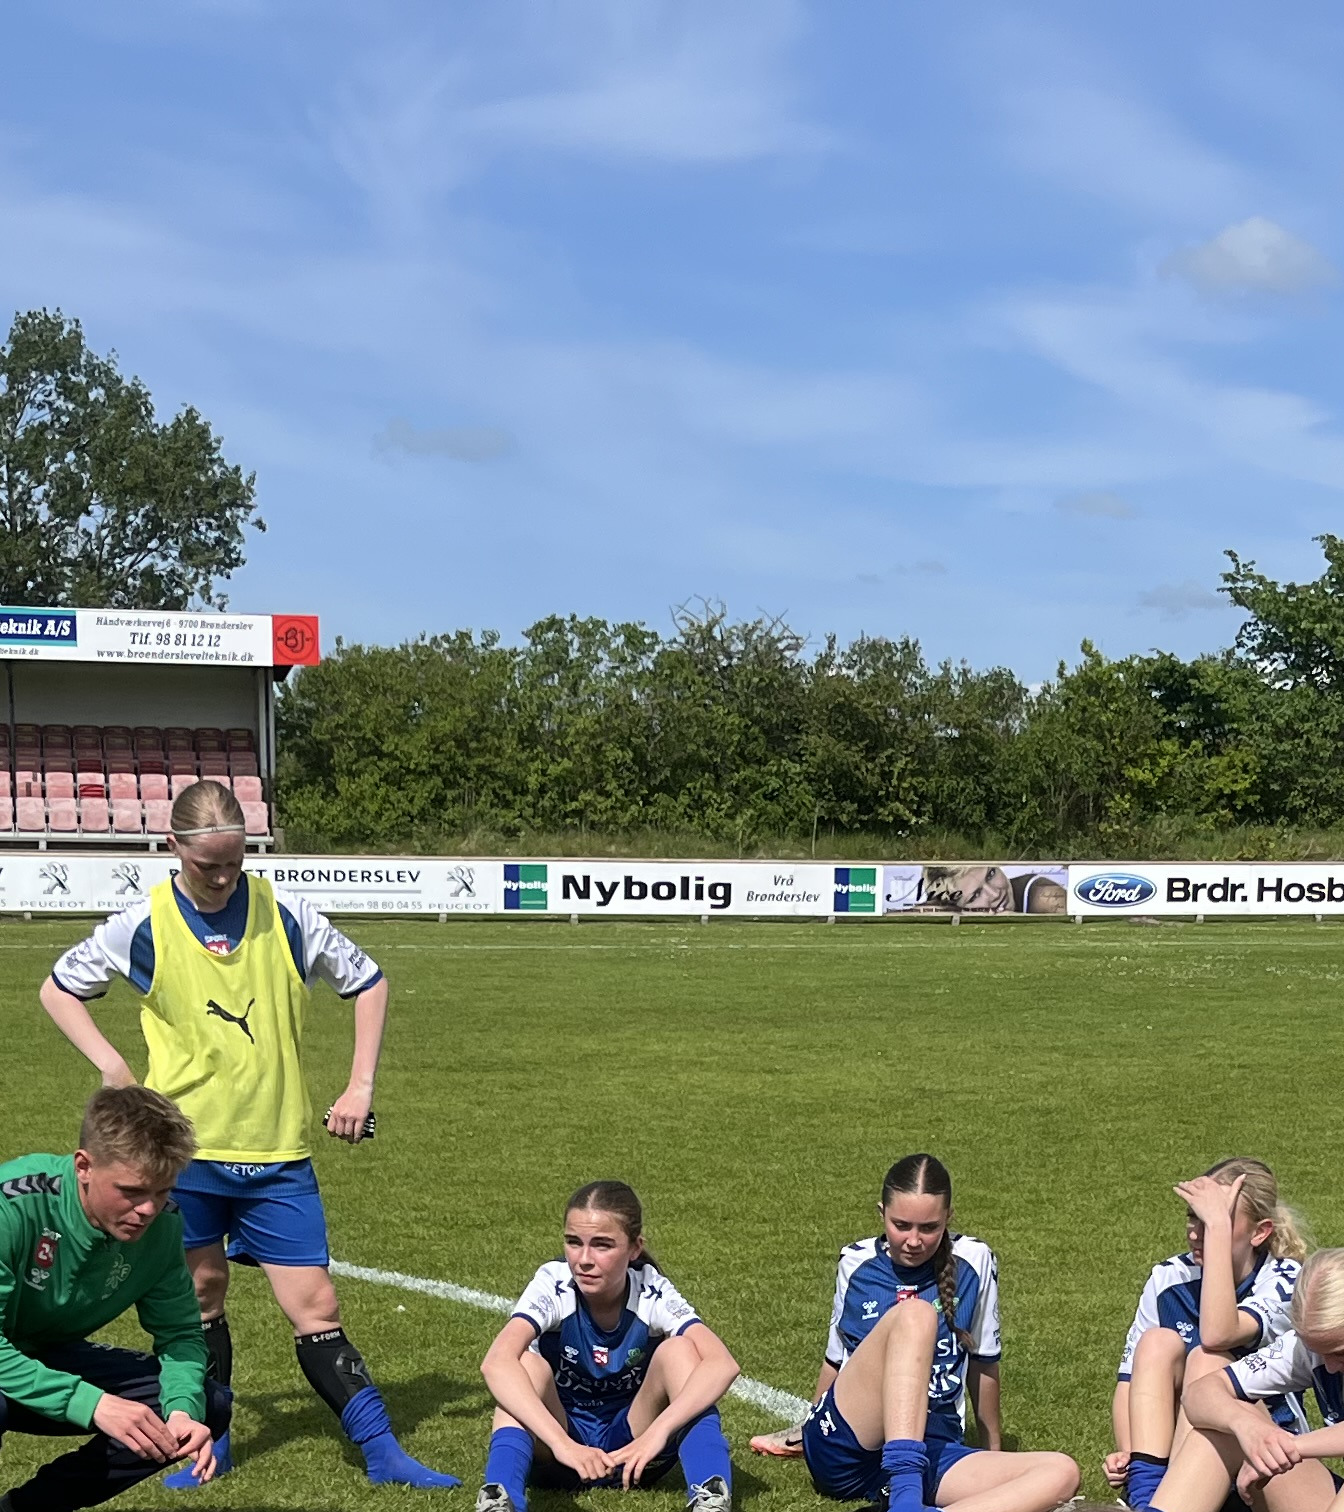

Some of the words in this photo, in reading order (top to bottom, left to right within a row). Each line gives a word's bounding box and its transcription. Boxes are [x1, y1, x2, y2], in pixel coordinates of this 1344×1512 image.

[43, 618, 72, 638] A/S
[178, 619, 199, 629] 9700
[199, 618, 254, 630] Brønderslev
[129, 631, 152, 646] Tlf.
[155, 632, 171, 646] 98
[174, 633, 187, 646] 81
[190, 633, 205, 647] 12
[207, 634, 221, 648] 12
[274, 868, 422, 884] BRØNDERSLEV
[772, 874, 794, 887] Vrå
[502, 879, 549, 892] Nybolig
[561, 874, 732, 910] Nybolig
[1088, 878, 1141, 902] Ford
[1166, 876, 1249, 903] Brdr.
[19, 900, 86, 908] PEUGEOT
[746, 890, 821, 904] Brønderslev
[366, 901, 380, 910] 98
[427, 903, 491, 911] PEUGEOT
